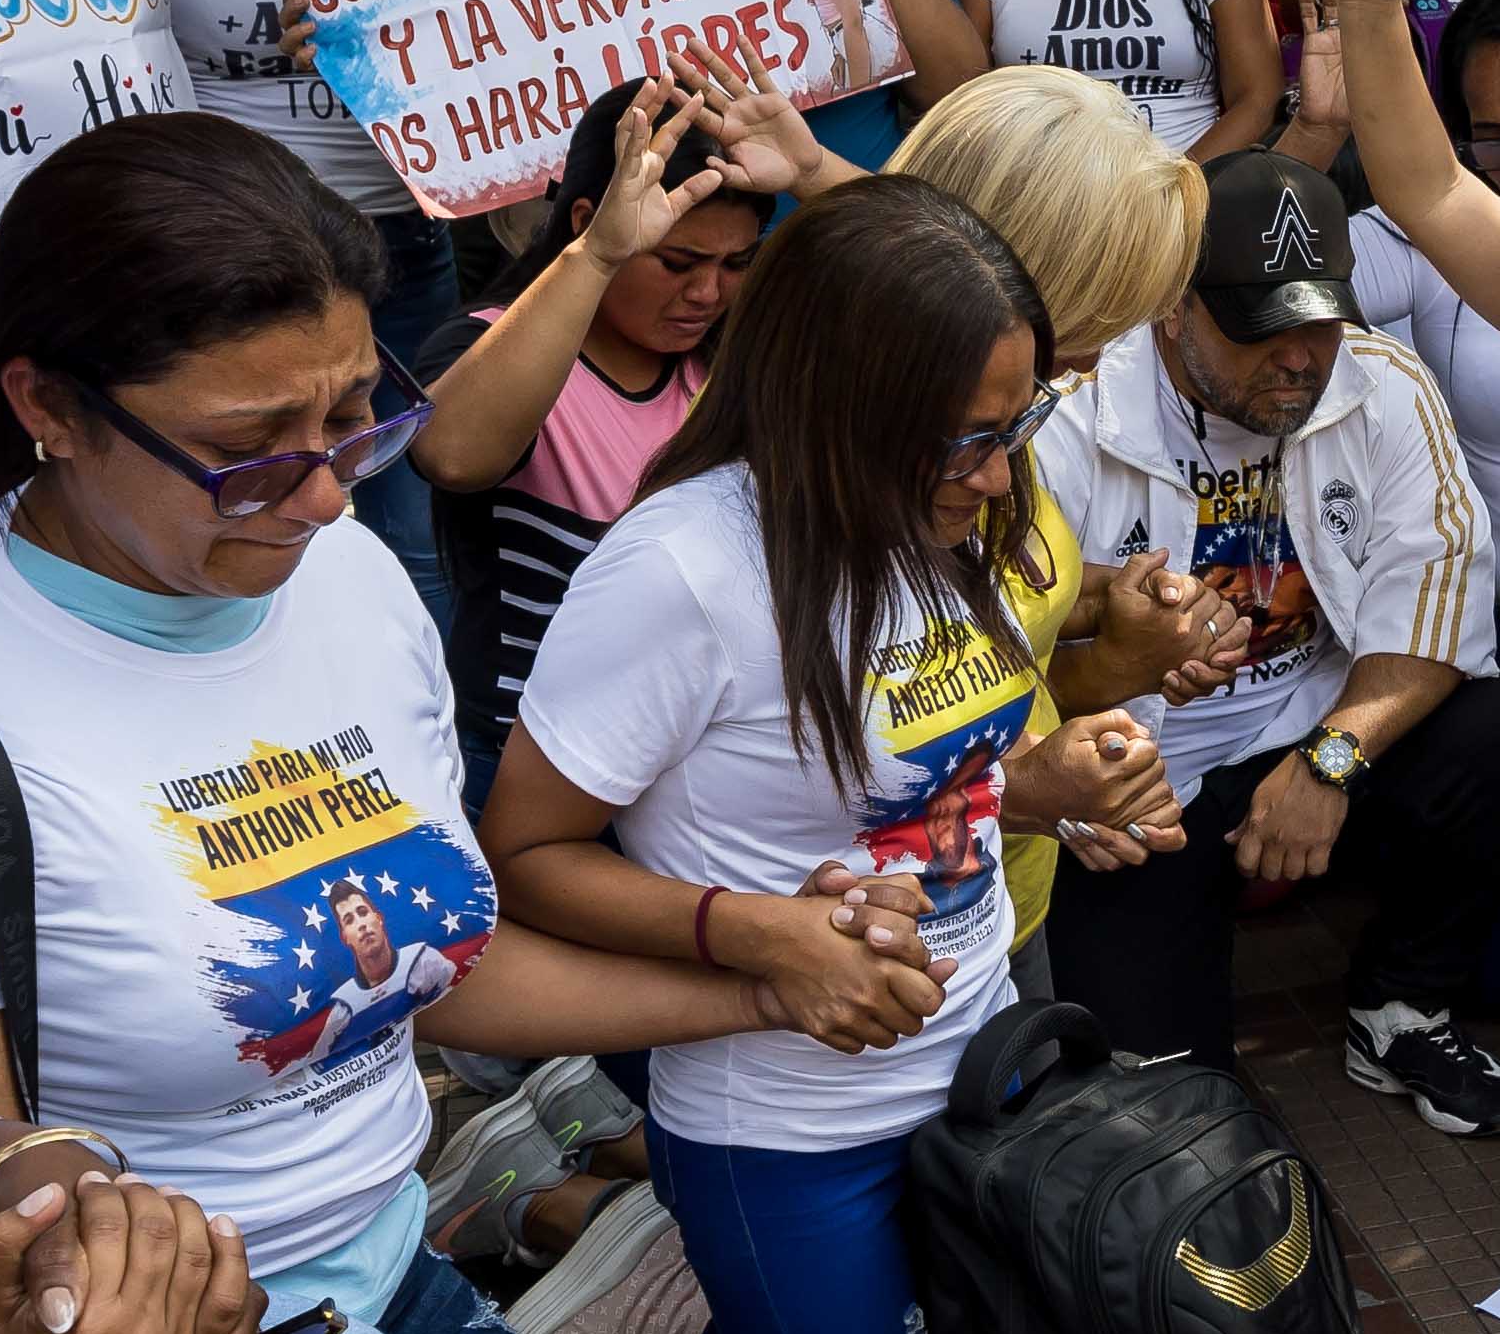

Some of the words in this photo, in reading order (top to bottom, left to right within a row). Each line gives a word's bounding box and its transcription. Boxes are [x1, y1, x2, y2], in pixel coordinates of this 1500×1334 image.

[380, 18, 417, 85] Y
[372, 112, 437, 176] OS
[160, 763, 261, 814] LIBERTAD
[255, 749, 316, 789] PARA
[308, 738, 340, 772] MI
[333, 724, 373, 764] HIJO
[196, 794, 325, 870] ANTHONY
[318, 767, 403, 829] PÉREZ
[935, 913, 970, 929] JUSTICIA
[976, 923, 993, 942] 21:21
[274, 1086, 307, 1103] TRAS
[306, 1079, 323, 1093] LA
[324, 1057, 365, 1086] JUSTICIA
[365, 1052, 373, 1065] Y
[372, 1046, 383, 1062] EL
